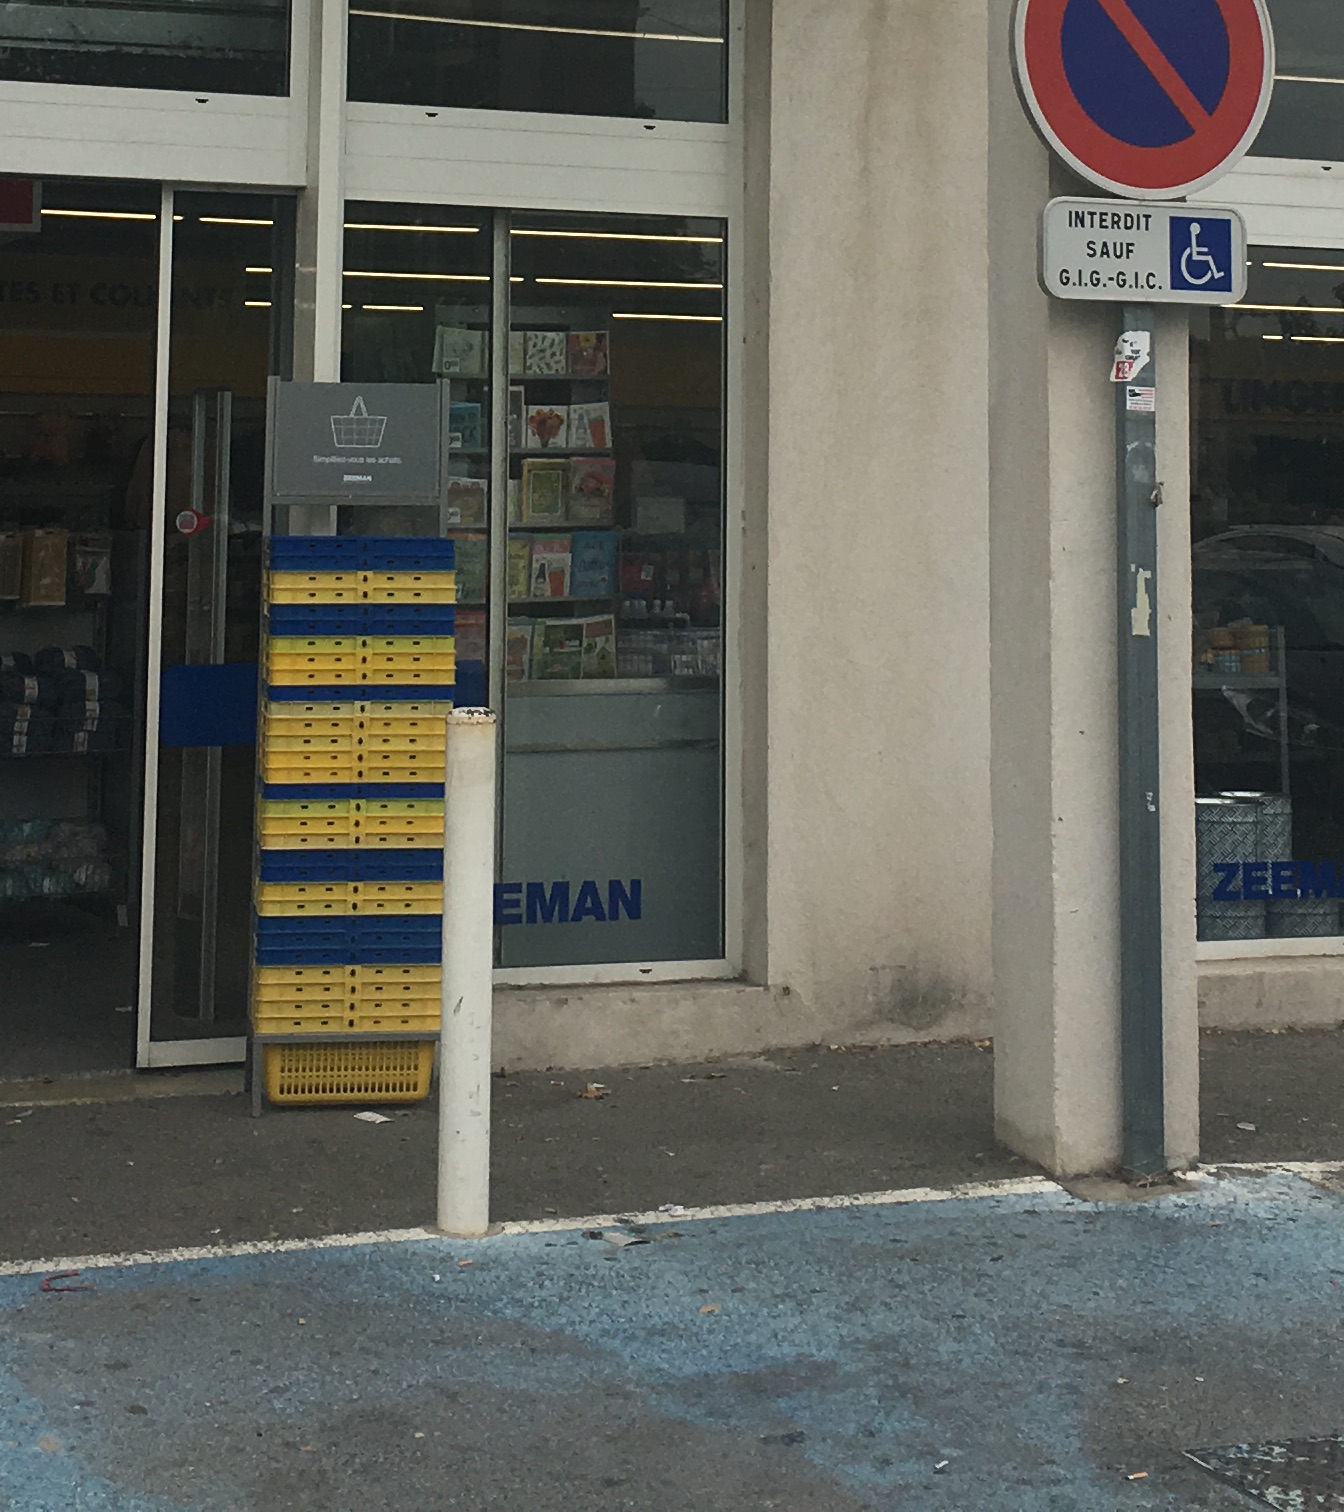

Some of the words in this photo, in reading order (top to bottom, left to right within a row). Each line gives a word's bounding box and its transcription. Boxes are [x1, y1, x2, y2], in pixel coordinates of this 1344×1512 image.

[1068, 210, 1152, 231] INTERDIT
[1086, 240, 1135, 259] SAUF
[1059, 268, 1162, 290] G.I.G.-G.I.C.
[493, 878, 643, 925] EMAN
